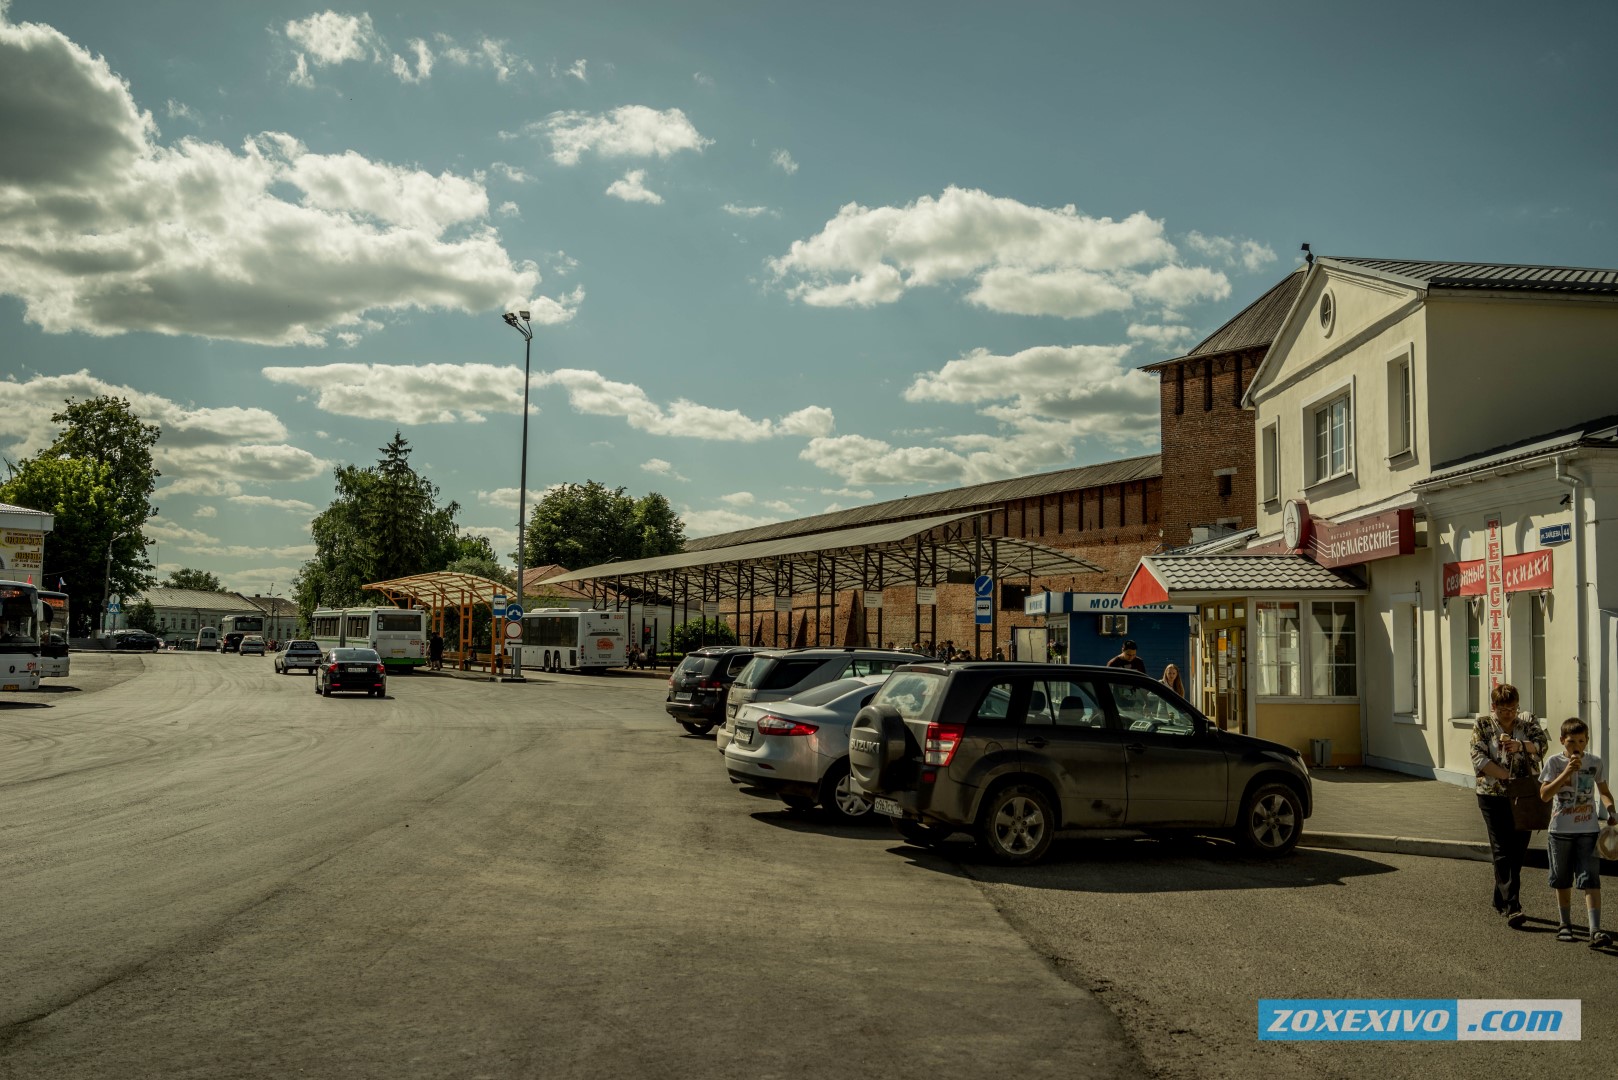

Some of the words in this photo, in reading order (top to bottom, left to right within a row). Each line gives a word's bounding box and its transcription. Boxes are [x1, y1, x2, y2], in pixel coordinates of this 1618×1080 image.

[1563, 528, 1570, 537] 44
[1330, 524, 1392, 564] КРЕМЛЕВСКИЙ
[850, 738, 880, 754] SUZUKI
